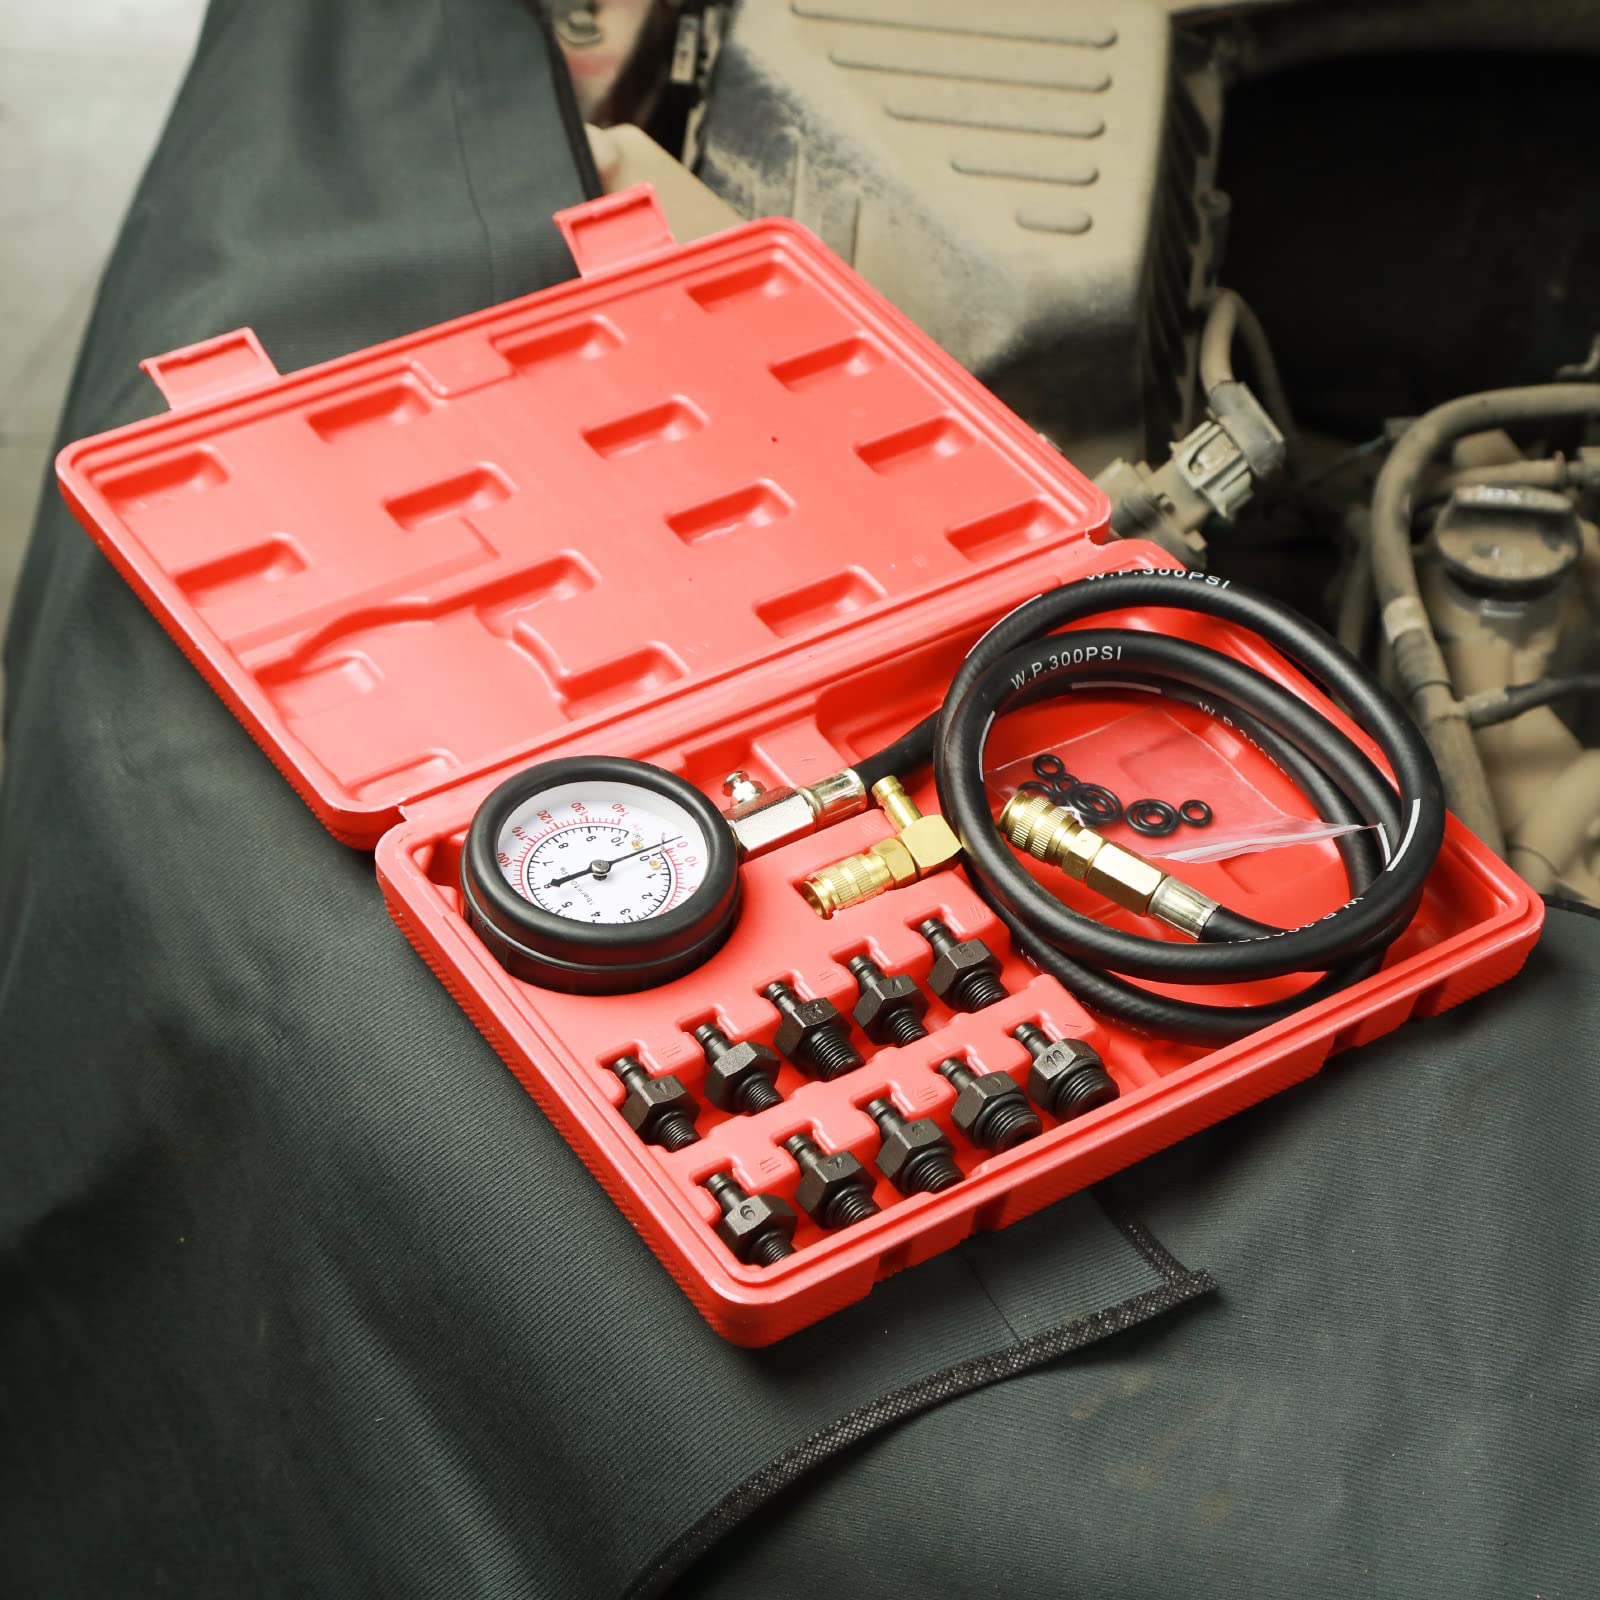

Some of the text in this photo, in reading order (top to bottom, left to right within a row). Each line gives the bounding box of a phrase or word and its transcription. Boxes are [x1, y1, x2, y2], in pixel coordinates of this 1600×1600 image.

[1010, 645, 1122, 690] W.P.300PSI
[571, 802, 588, 816] 130
[611, 803, 629, 817] 140
[537, 810, 554, 825] 120
[512, 826, 528, 840] 110
[611, 836, 625, 847] 10
[497, 852, 512, 868] 100
[685, 856, 699, 867] 10
[641, 892, 653, 900] 2
[561, 901, 573, 909] 5
[1046, 1049, 1065, 1067] 10
[739, 1204, 755, 1221] 6
